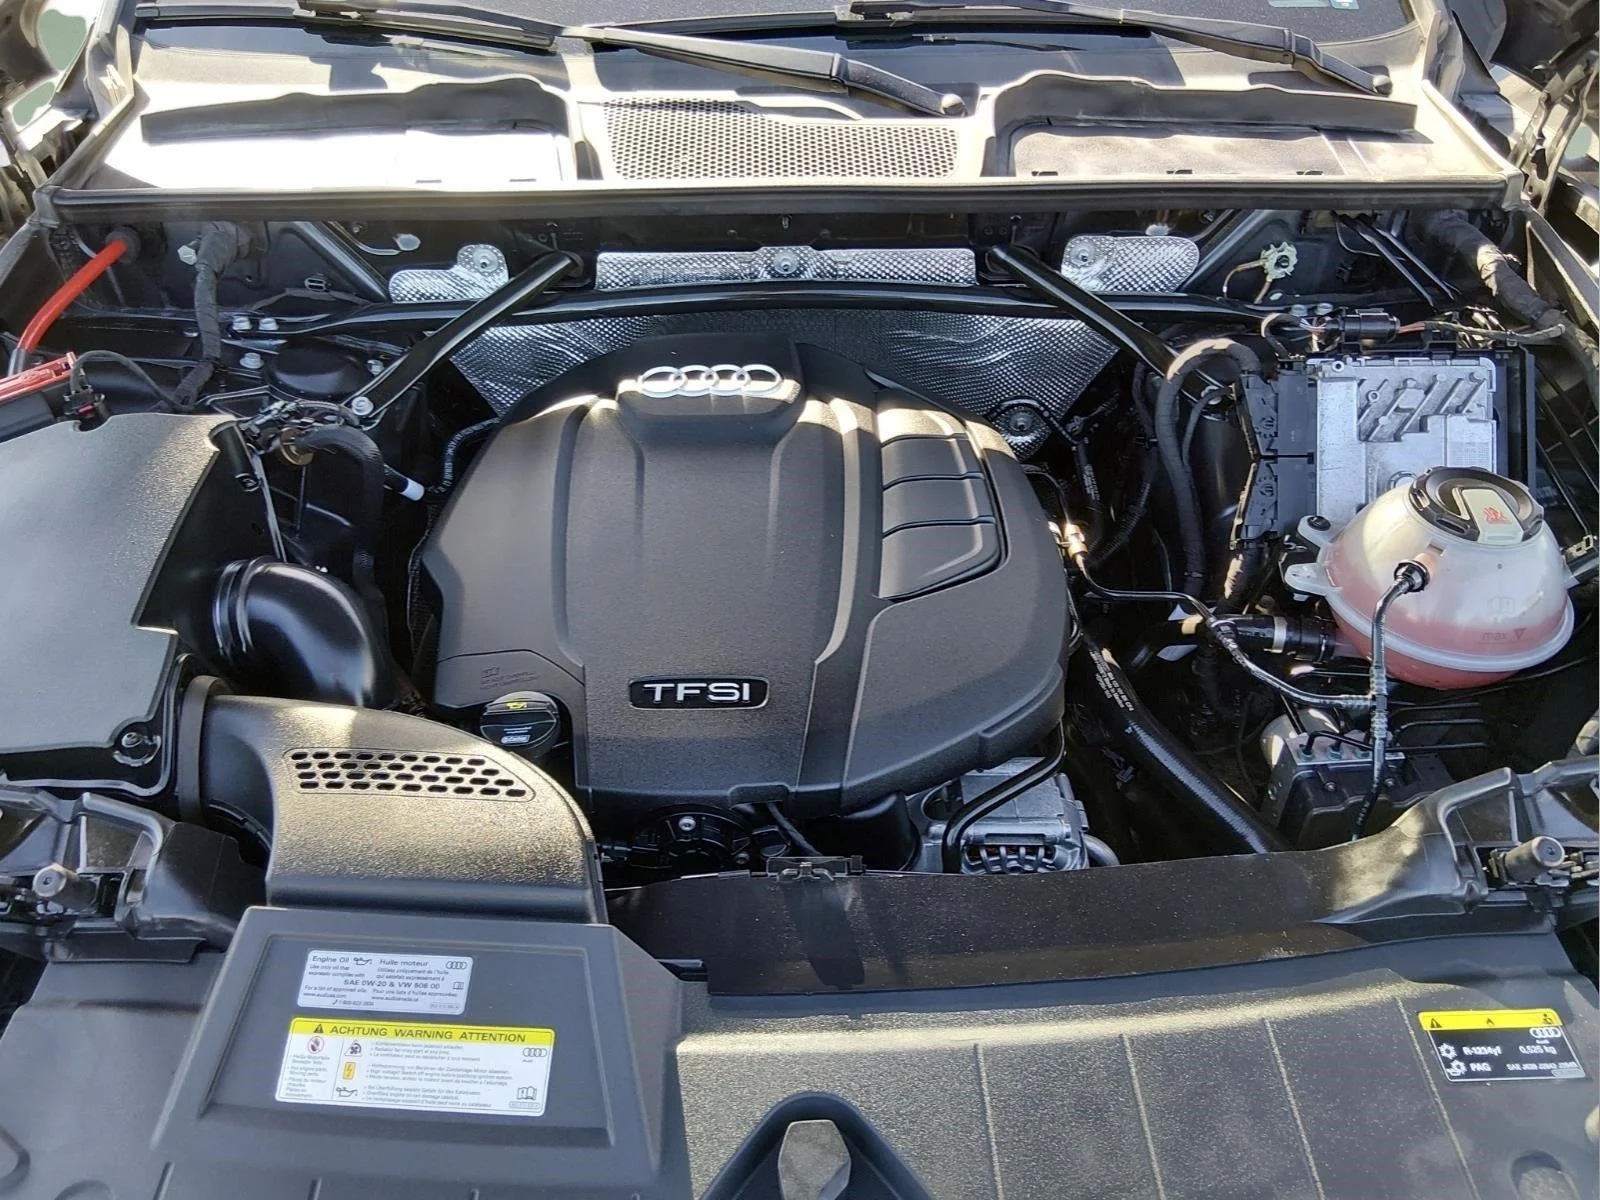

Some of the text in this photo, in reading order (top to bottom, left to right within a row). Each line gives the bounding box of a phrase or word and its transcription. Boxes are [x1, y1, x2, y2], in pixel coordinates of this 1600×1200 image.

[643, 682, 750, 702] TFSI
[312, 954, 349, 963] Engine Oil
[379, 958, 398, 966] Huile
[330, 1025, 526, 1043] ACHTUNG WARNING ATTENTION
[1469, 1062, 1492, 1072] PAG
